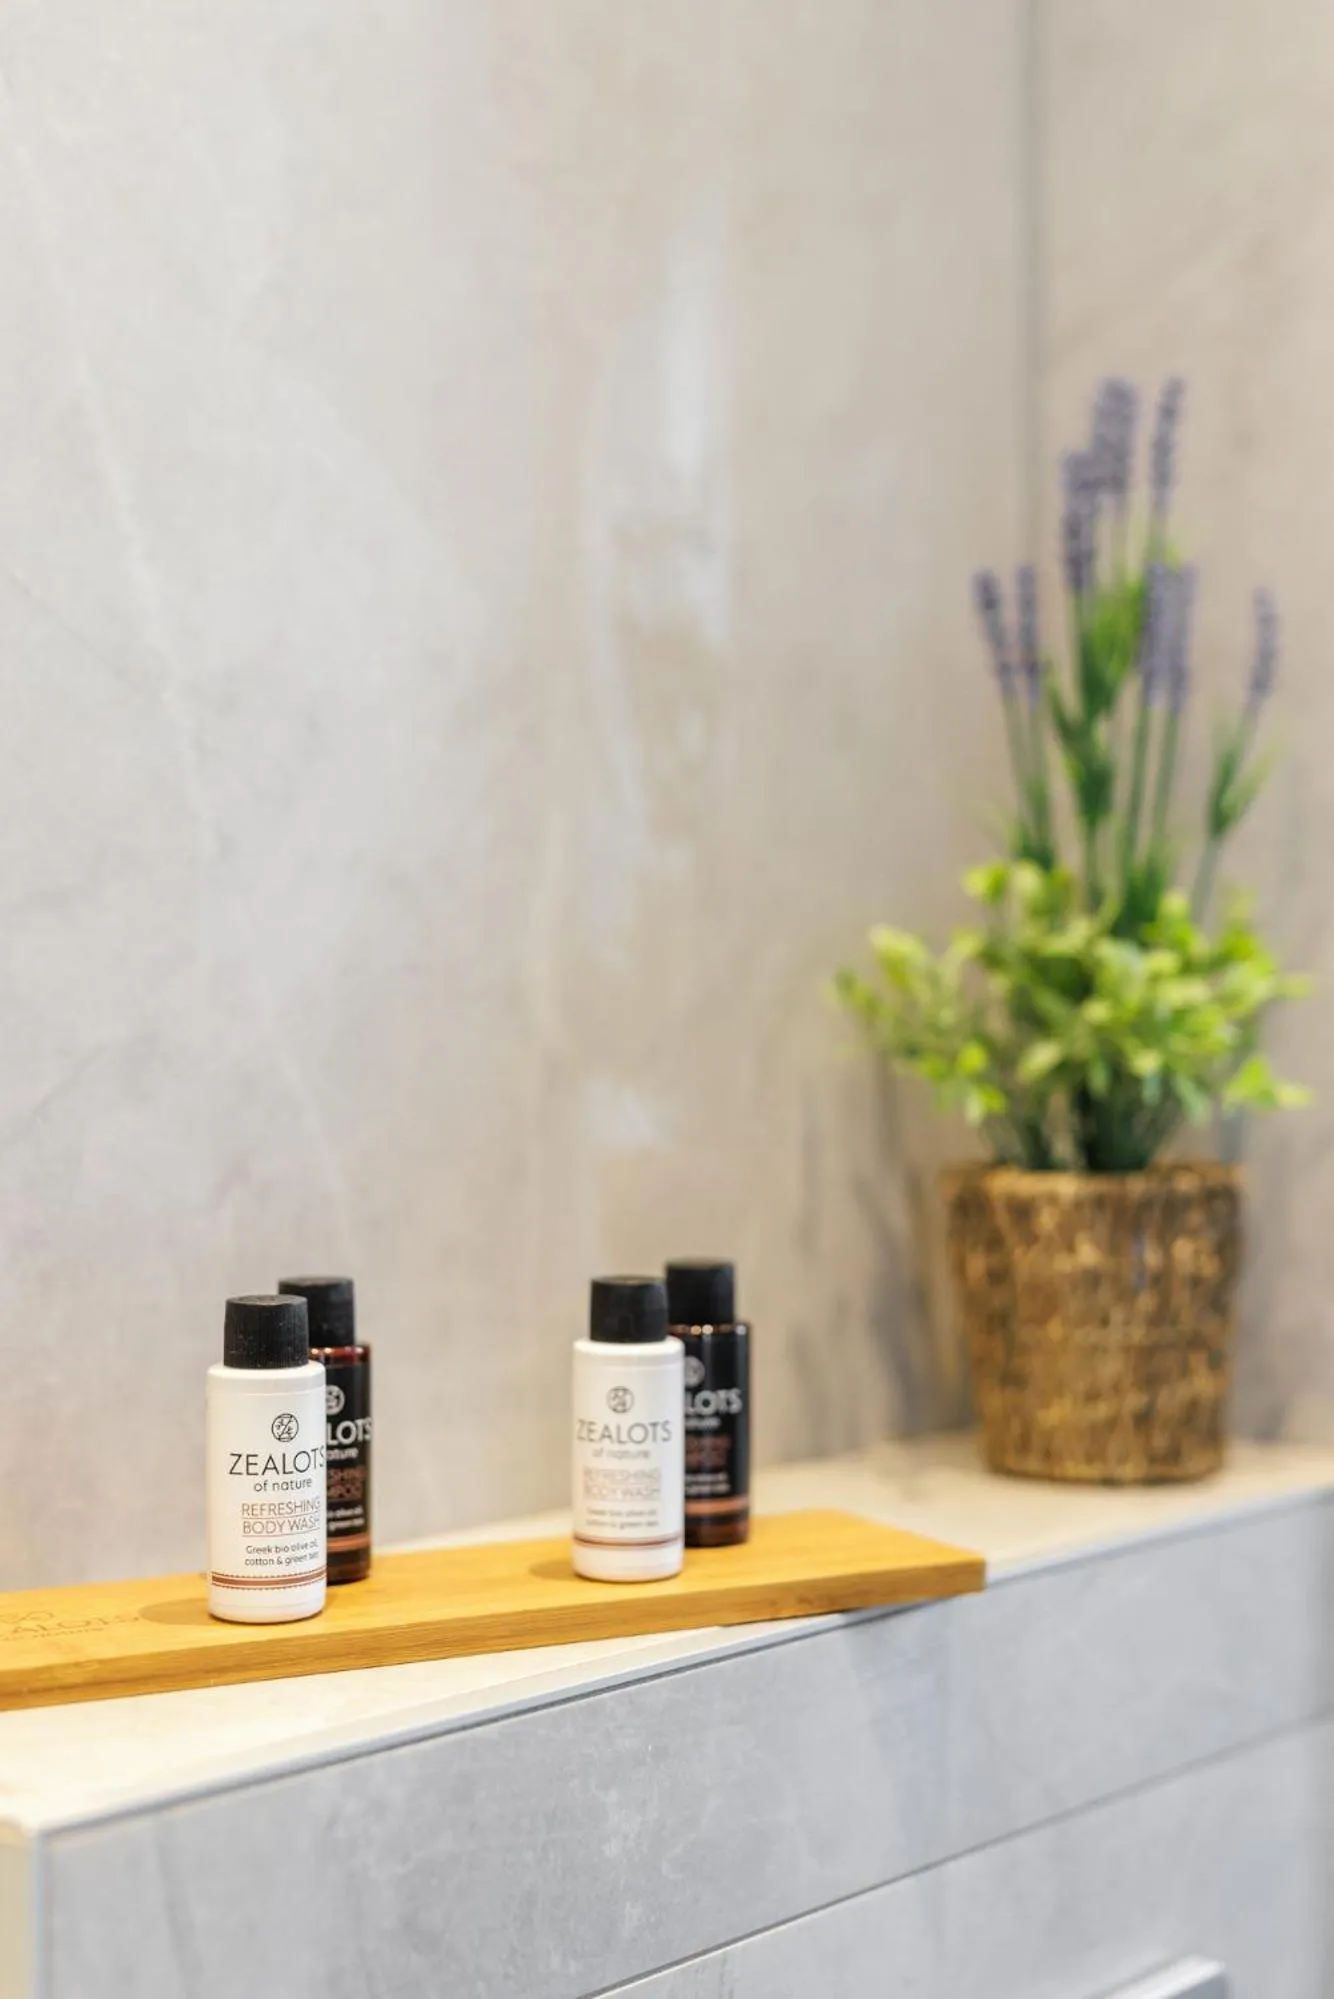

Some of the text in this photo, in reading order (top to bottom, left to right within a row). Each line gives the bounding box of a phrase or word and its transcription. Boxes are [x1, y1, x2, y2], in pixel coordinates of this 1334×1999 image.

[685, 1388, 743, 1416] LOTS
[327, 1417, 372, 1445] LOTS
[576, 1419, 672, 1444] ZEALOTS
[228, 1446, 326, 1476] ZEALOTS
[254, 1479, 267, 1492] of
[272, 1478, 312, 1492] nature
[241, 1496, 321, 1517] REFRESHING
[243, 1520, 286, 1535] BODY
[245, 1545, 273, 1555] Greek
[275, 1544, 290, 1554] bio
[244, 1557, 274, 1567] cotton
[276, 1555, 283, 1566] &
